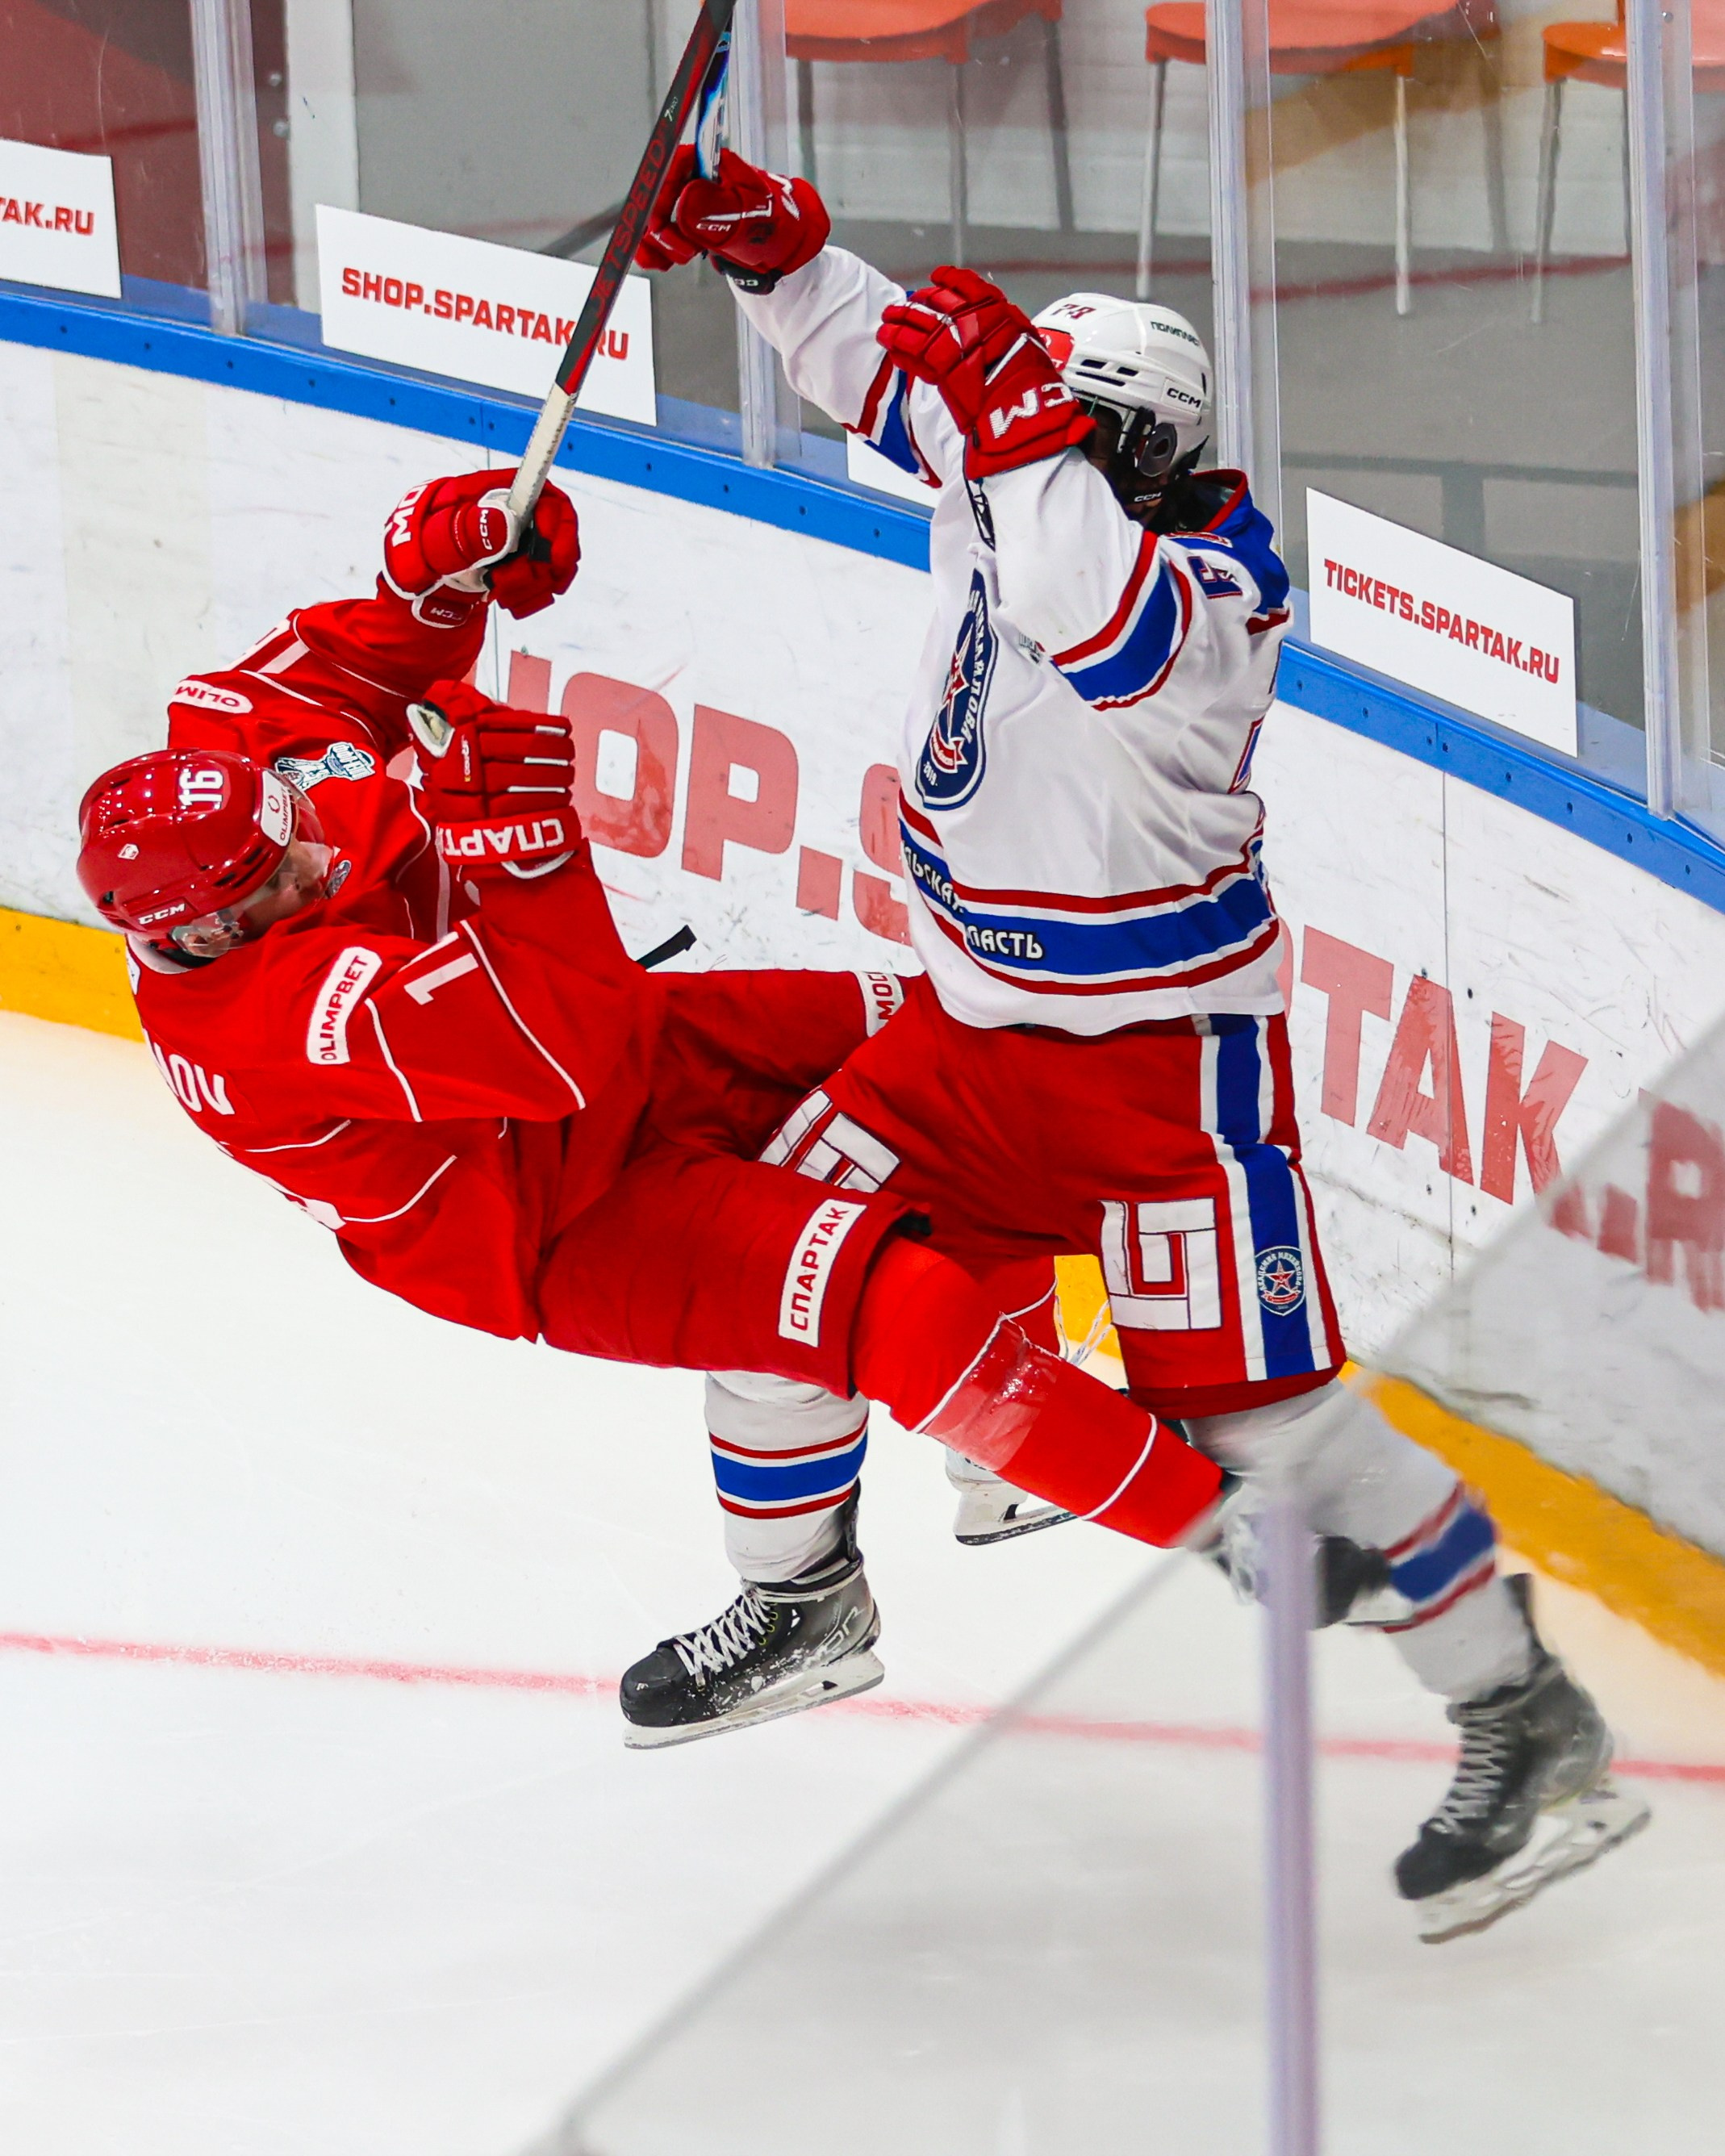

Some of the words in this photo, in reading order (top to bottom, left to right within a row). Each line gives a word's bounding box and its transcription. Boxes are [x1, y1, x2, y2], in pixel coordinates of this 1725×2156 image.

[341, 267, 629, 361] SHOP.SPARTAKU
[989, 382, 1073, 438] CM
[1167, 387, 1201, 408] CCM
[1134, 491, 1162, 503] CCM
[479, 509, 493, 550] CCM
[1324, 558, 1560, 685] TICKETS.SPARTAK.RU
[175, 686, 240, 708] OLIM
[178, 770, 224, 809] 16
[436, 818, 565, 856] СПАРТ
[138, 903, 186, 925] CCM
[967, 925, 1044, 959] ЛАСТЬ
[320, 955, 369, 1061] OLIMPBET
[863, 971, 896, 1020] МОС
[790, 1207, 850, 1331] СПАРТАК
